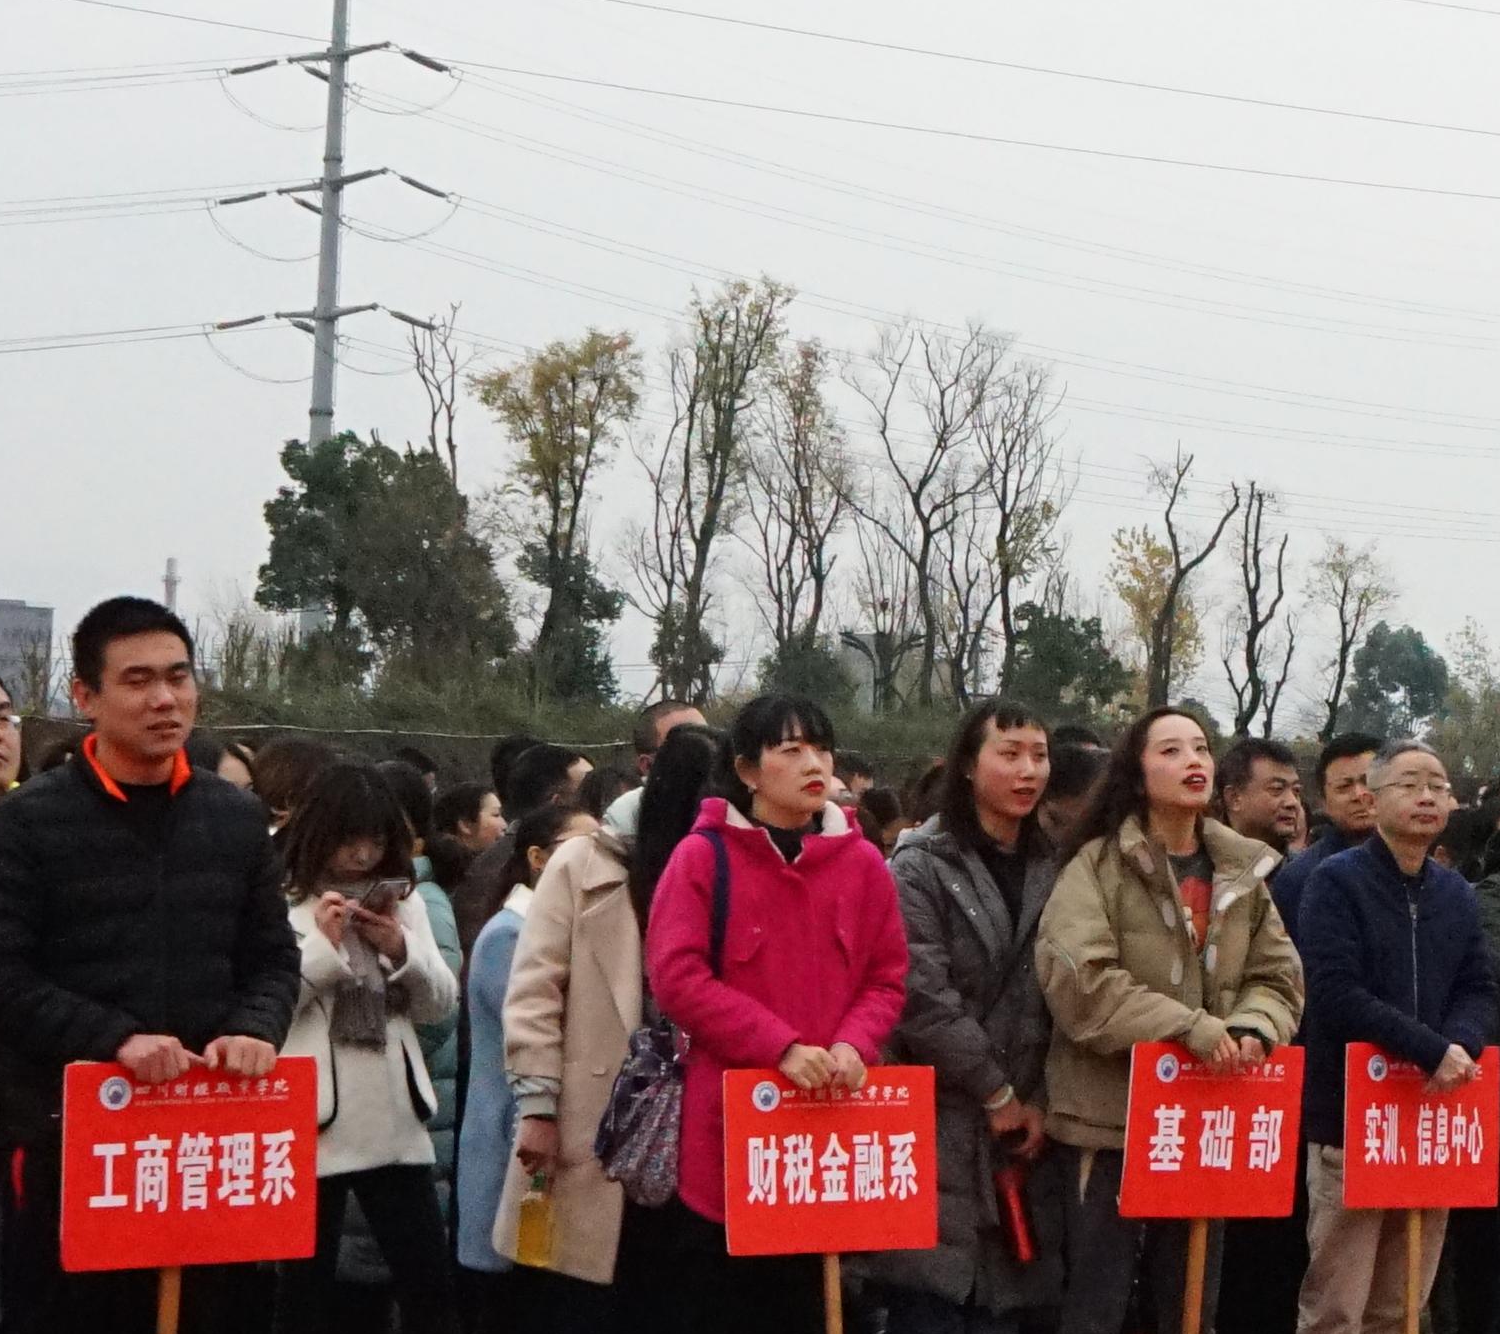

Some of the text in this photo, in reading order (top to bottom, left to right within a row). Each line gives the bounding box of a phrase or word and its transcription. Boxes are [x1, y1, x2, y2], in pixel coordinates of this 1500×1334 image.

[746, 1130, 919, 1206] 财税金融系
[1148, 1103, 1284, 1173] 基础部
[1364, 1101, 1484, 1167] 实训、信息中心
[88, 1128, 296, 1214] 工商管理系
